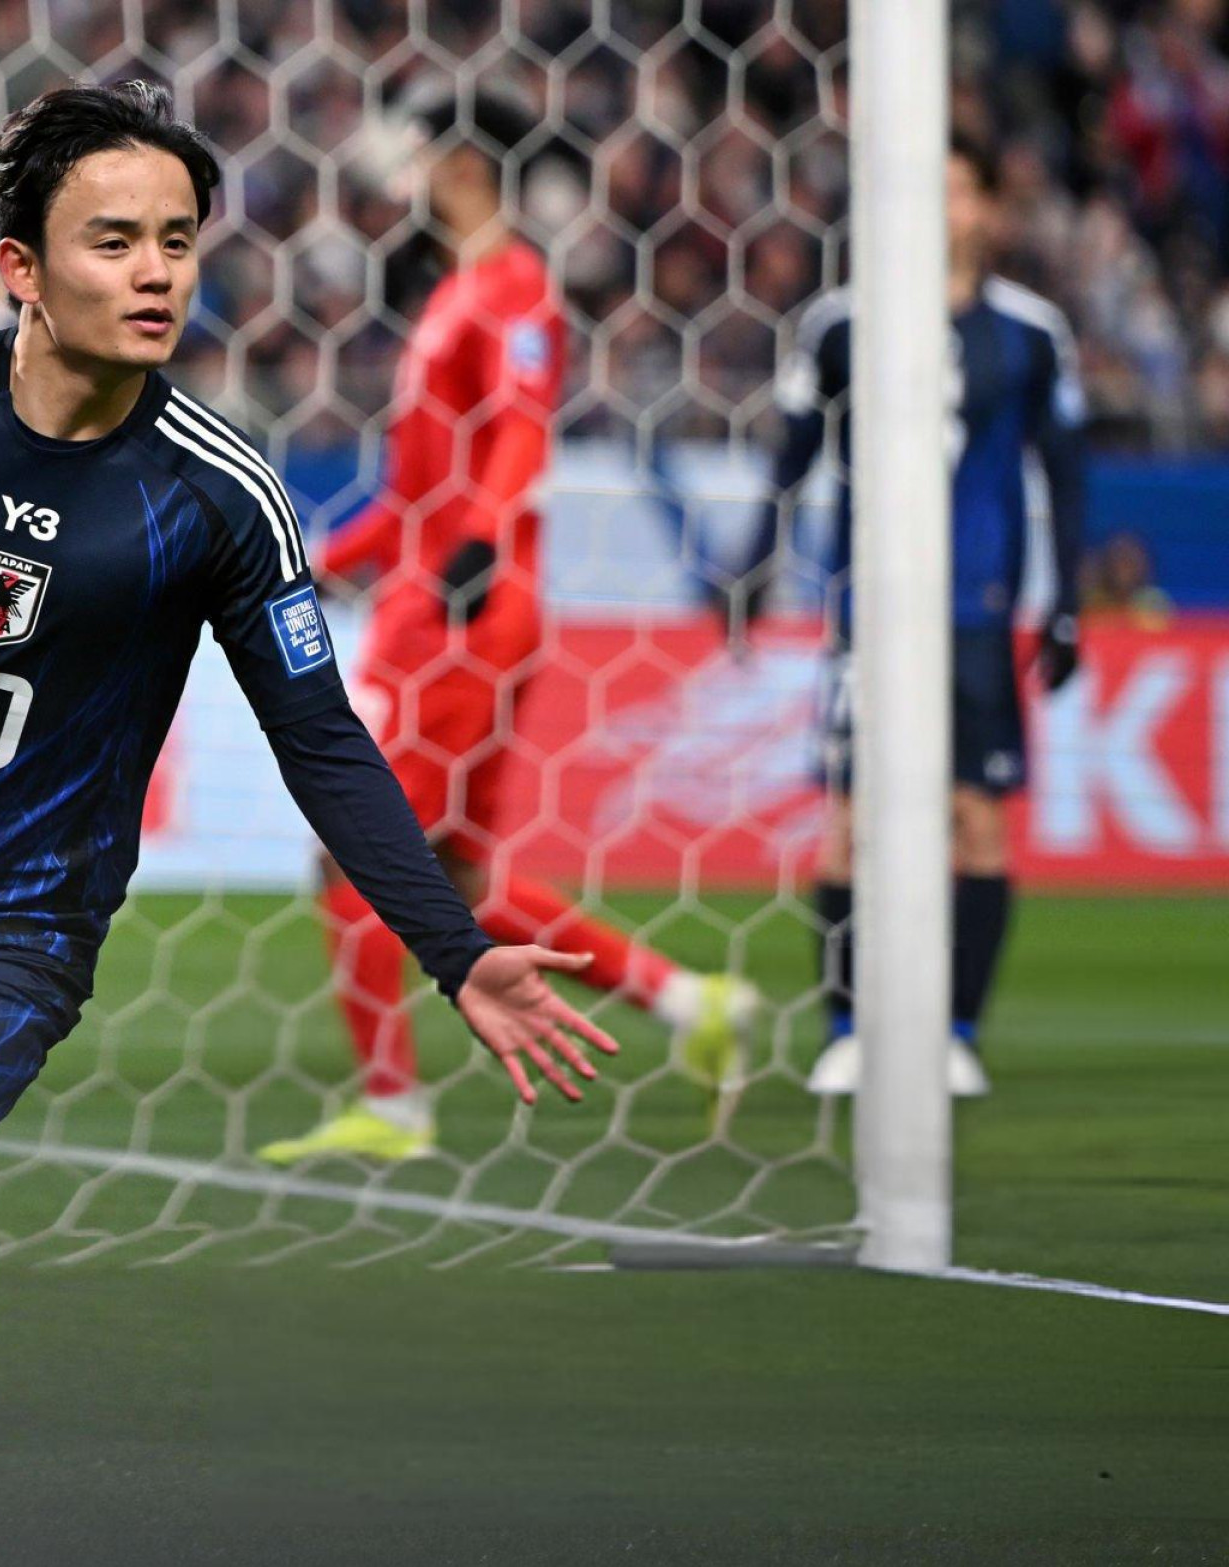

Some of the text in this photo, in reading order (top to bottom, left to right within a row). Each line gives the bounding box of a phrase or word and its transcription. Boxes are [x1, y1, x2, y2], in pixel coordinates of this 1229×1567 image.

[1, 494, 60, 542] Y-3
[282, 599, 314, 619] FOOTBALL
[286, 610, 317, 633] UNITES
